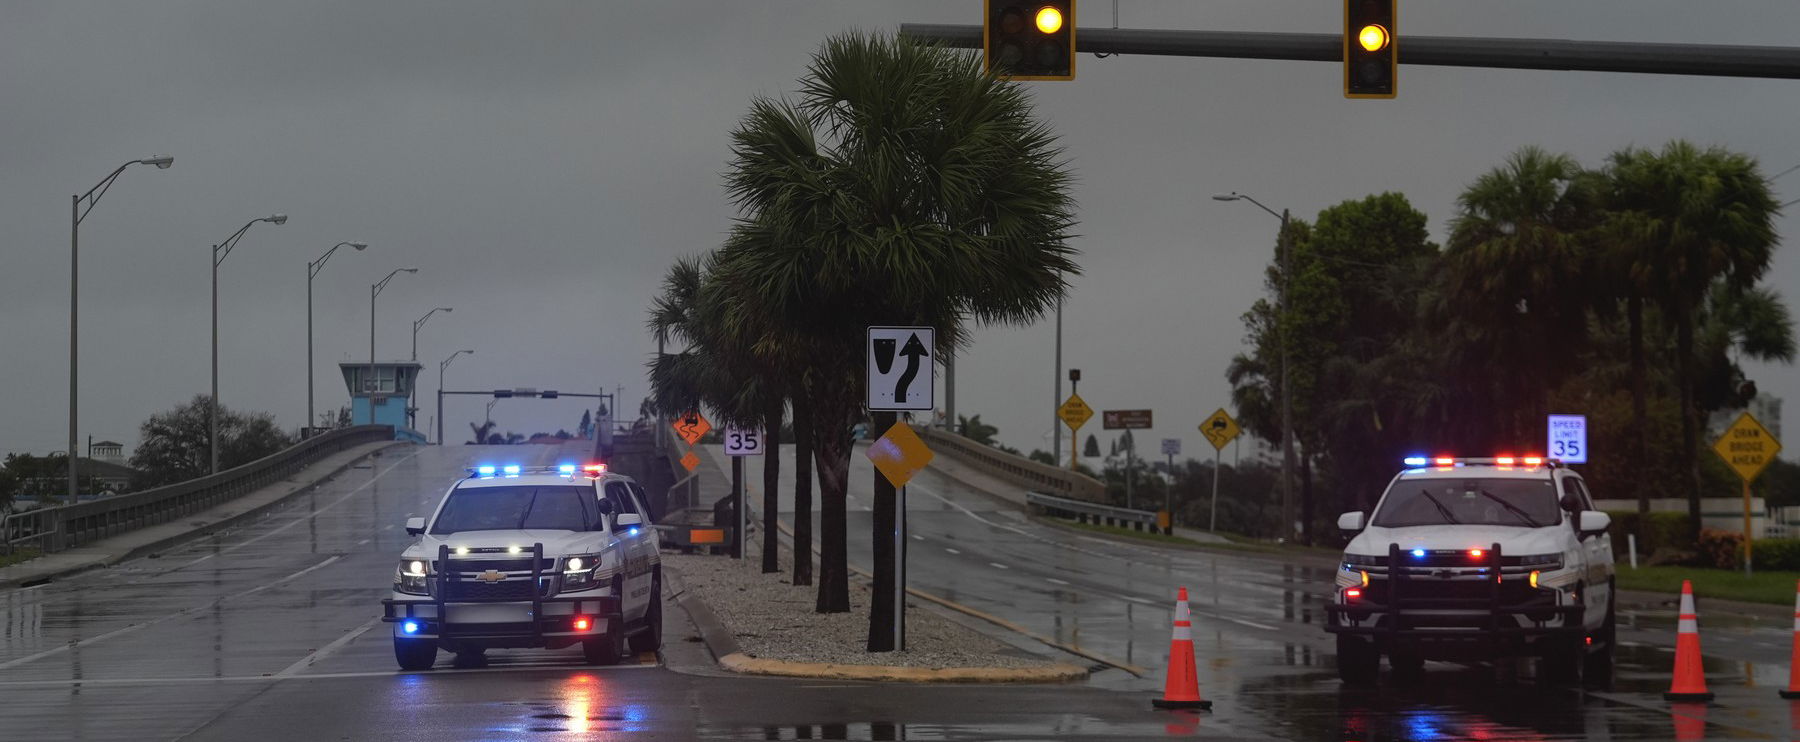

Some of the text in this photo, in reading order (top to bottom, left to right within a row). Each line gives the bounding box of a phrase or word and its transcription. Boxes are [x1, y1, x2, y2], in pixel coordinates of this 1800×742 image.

[1554, 430, 1577, 438] LIMIT
[1734, 428, 1760, 438] DRAW
[730, 434, 758, 450] 35
[1730, 441, 1763, 452] BRIDGE
[1554, 440, 1580, 456] 35
[1732, 455, 1763, 464] AHEAD
